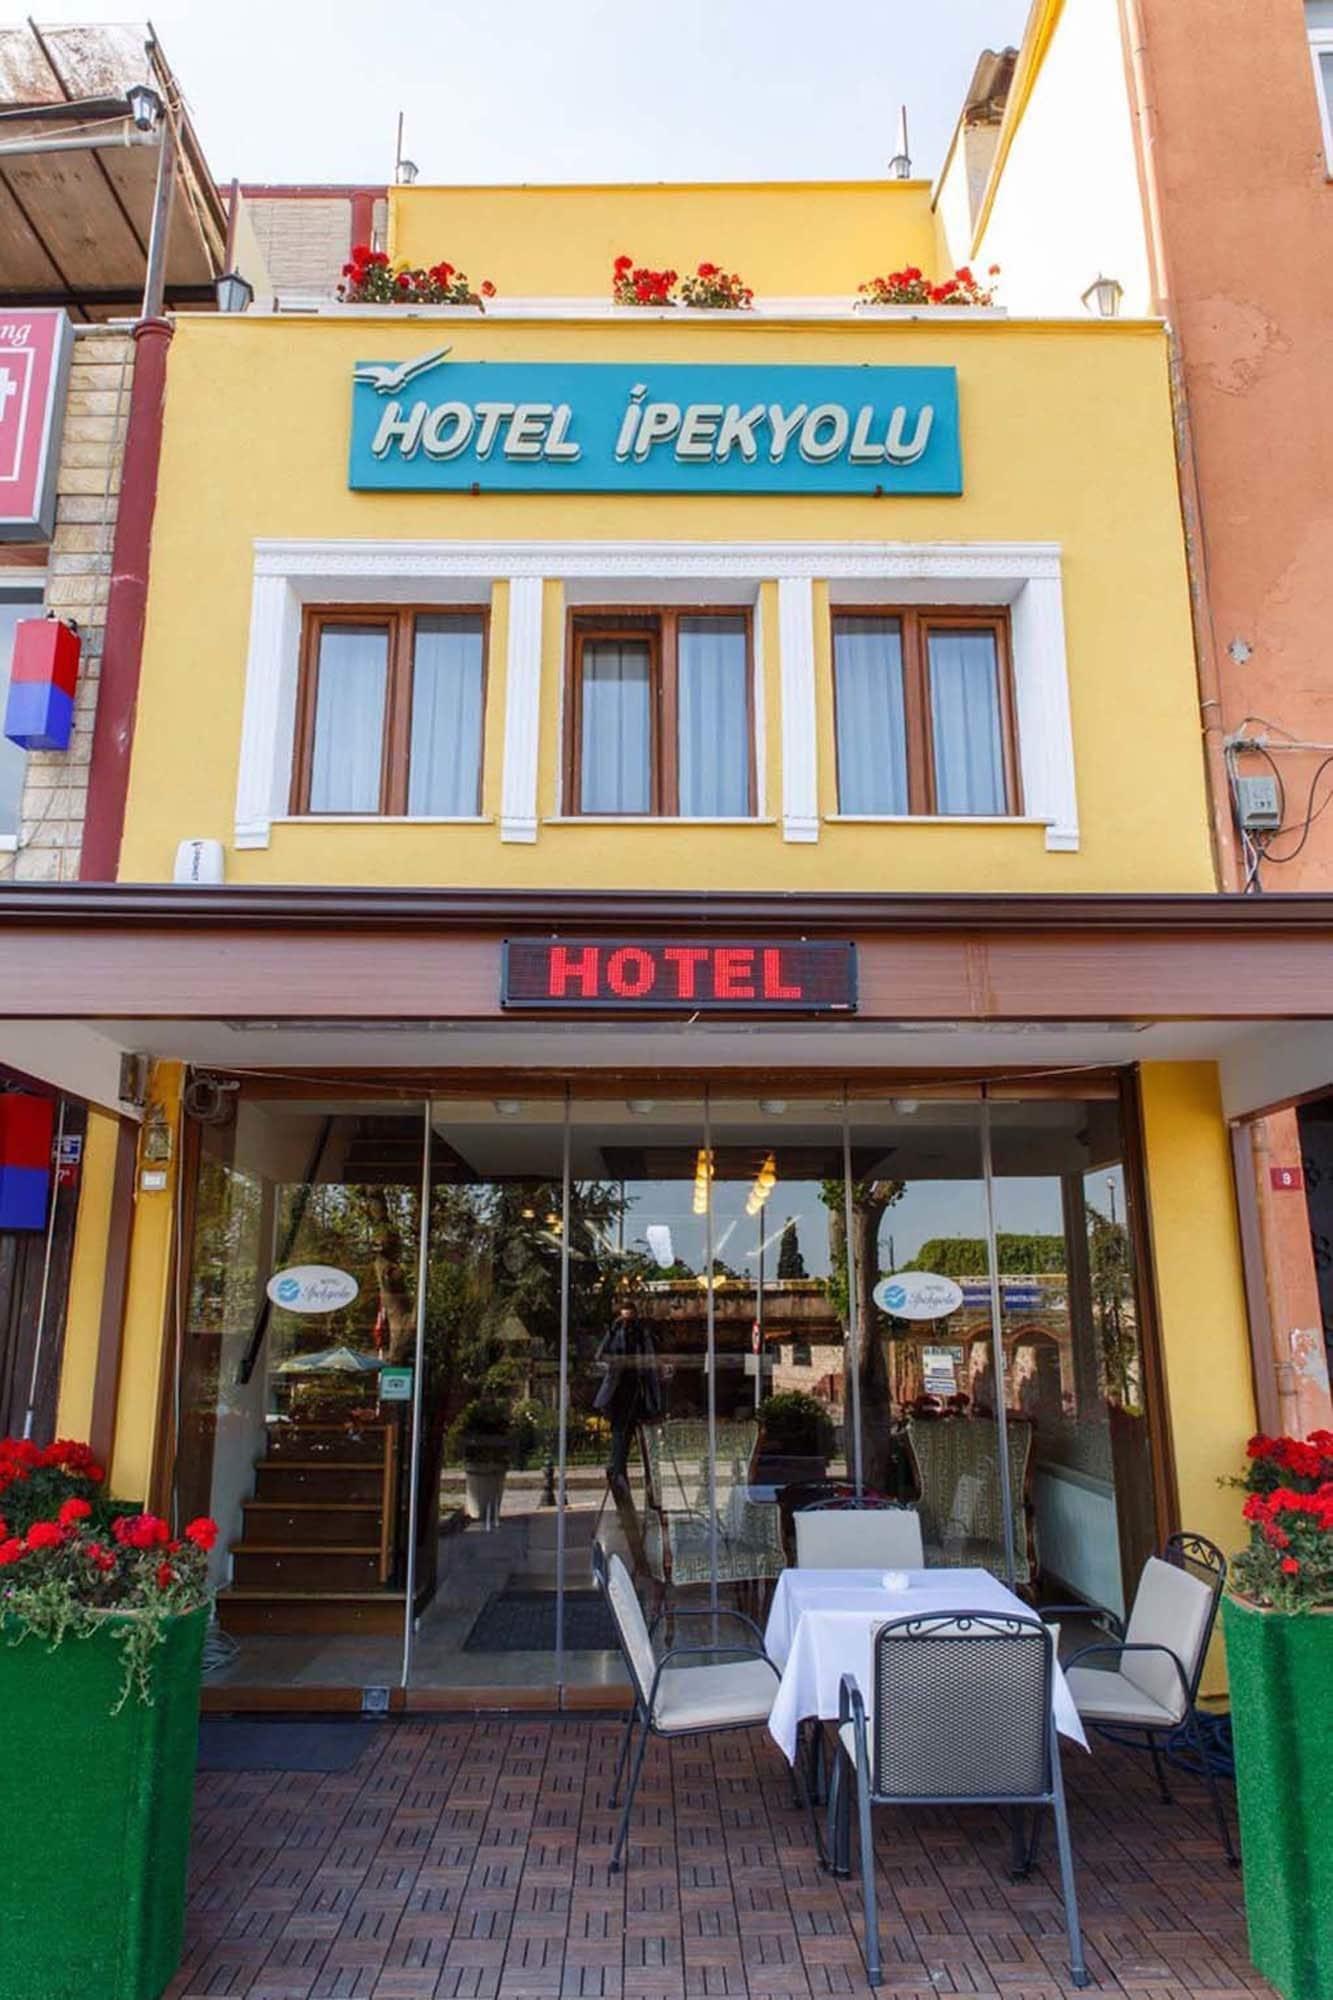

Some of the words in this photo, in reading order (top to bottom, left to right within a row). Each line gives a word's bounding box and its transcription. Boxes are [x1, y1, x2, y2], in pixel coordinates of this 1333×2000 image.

[371, 401, 581, 461] HOTEL
[615, 383, 934, 464] İPEKYOLU
[549, 947, 802, 998] HOTEL
